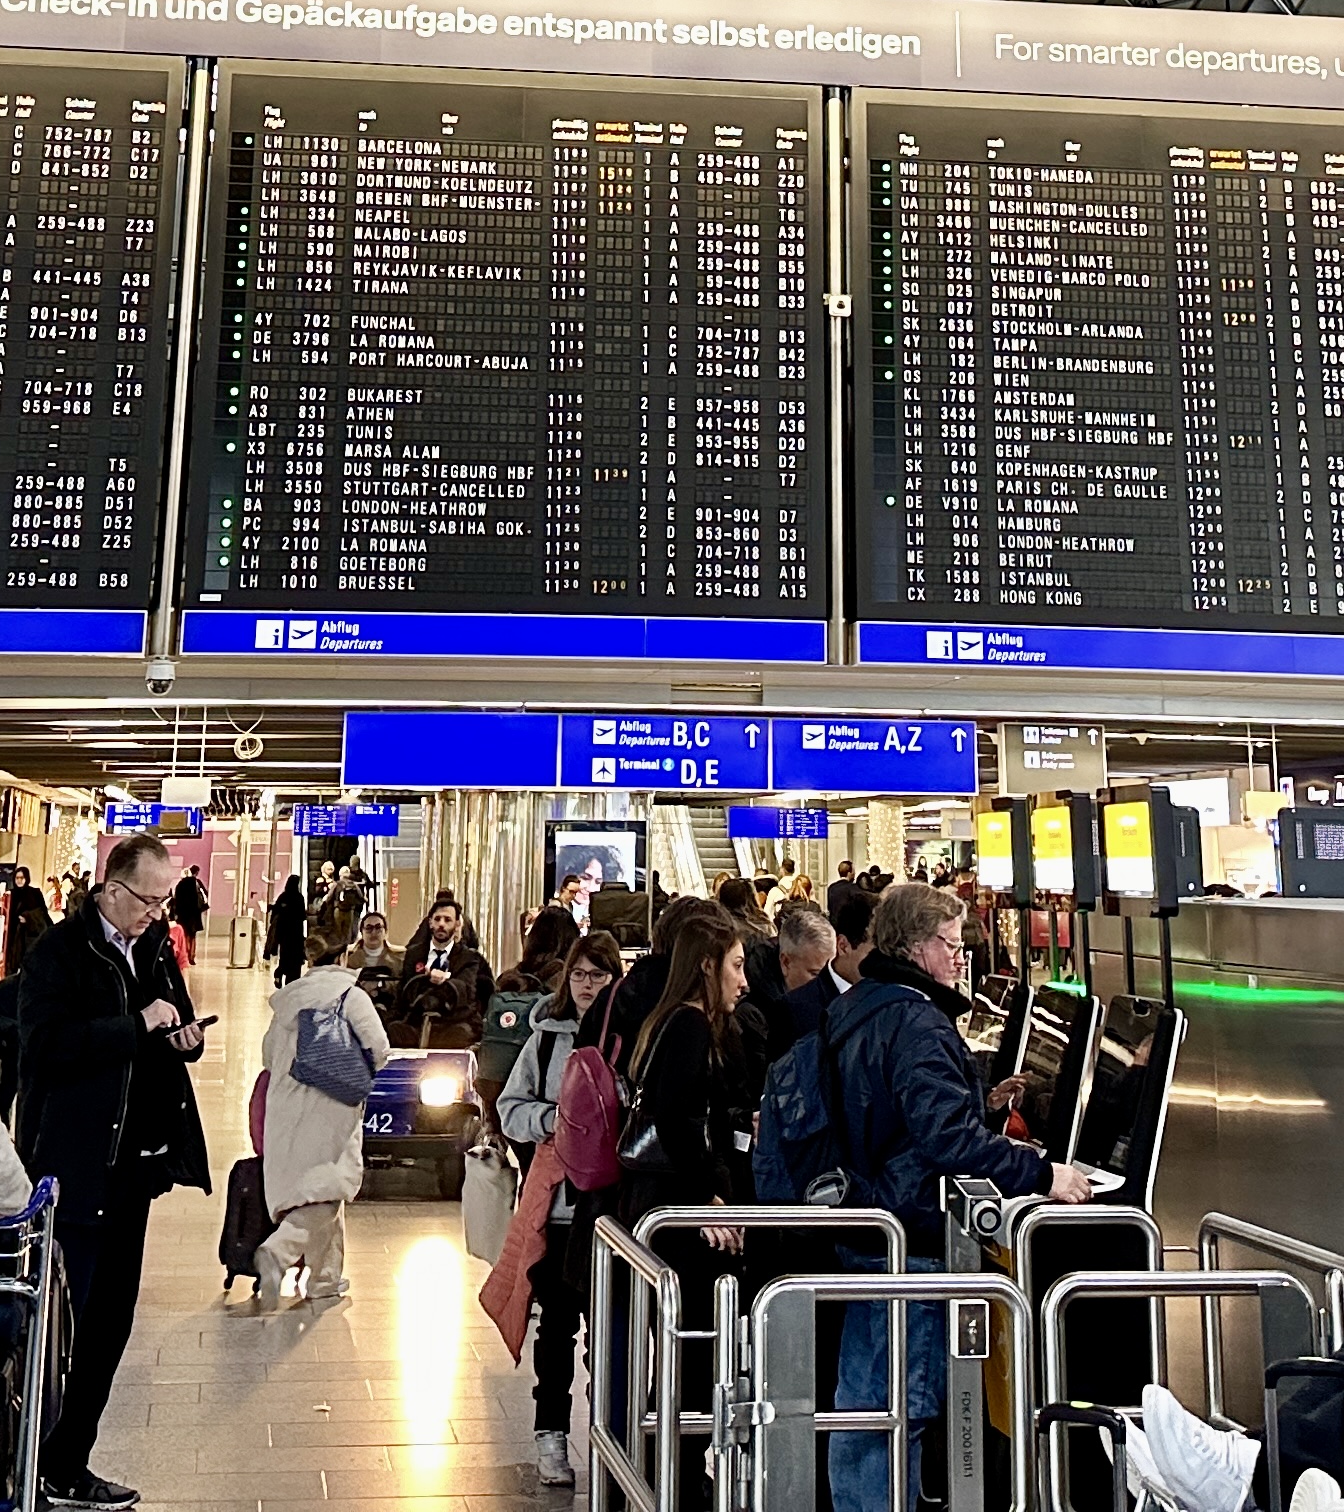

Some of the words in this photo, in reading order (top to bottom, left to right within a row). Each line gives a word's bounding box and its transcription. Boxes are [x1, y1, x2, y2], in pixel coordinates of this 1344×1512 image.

[502, 12, 668, 47] entspannt
[672, 16, 770, 50] selbst
[774, 23, 921, 59] erledigen
[995, 33, 1042, 61] For
[1048, 40, 1160, 67] smarter
[1166, 42, 1327, 80] departures,
[347, 389, 423, 404] BUKAREST
[995, 444, 1031, 458] GENF
[342, 499, 487, 516] LONDON-HEATHROW
[696, 508, 759, 523] 901-904
[12, 513, 82, 529] 880-885
[104, 515, 133, 530] D52
[997, 517, 1061, 531] HAMBURG
[339, 557, 427, 572] GOETEBORG
[999, 554, 1053, 568] BEIRUT
[339, 576, 415, 590] BRUESSEL
[695, 582, 760, 597] 259-488
[779, 584, 806, 598] A15
[1001, 573, 1072, 587] ISTANBUL
[1000, 591, 1036, 605] HONG
[1046, 592, 1082, 605] KONG
[321, 621, 359, 636] Abflug
[320, 637, 383, 651] Departures
[987, 633, 1023, 647] Abflug
[988, 649, 1046, 662] Departures
[619, 734, 670, 747] Departures
[620, 721, 651, 734] Abflug
[673, 722, 710, 749] B,C
[828, 727, 859, 738] Abflug
[884, 727, 923, 753] A,Z
[828, 738, 879, 752] Departures
[620, 758, 659, 771] Terminal
[681, 759, 719, 787] D,E
[962, 1391, 971, 1414] FDK
[962, 1425, 972, 1448] 200
